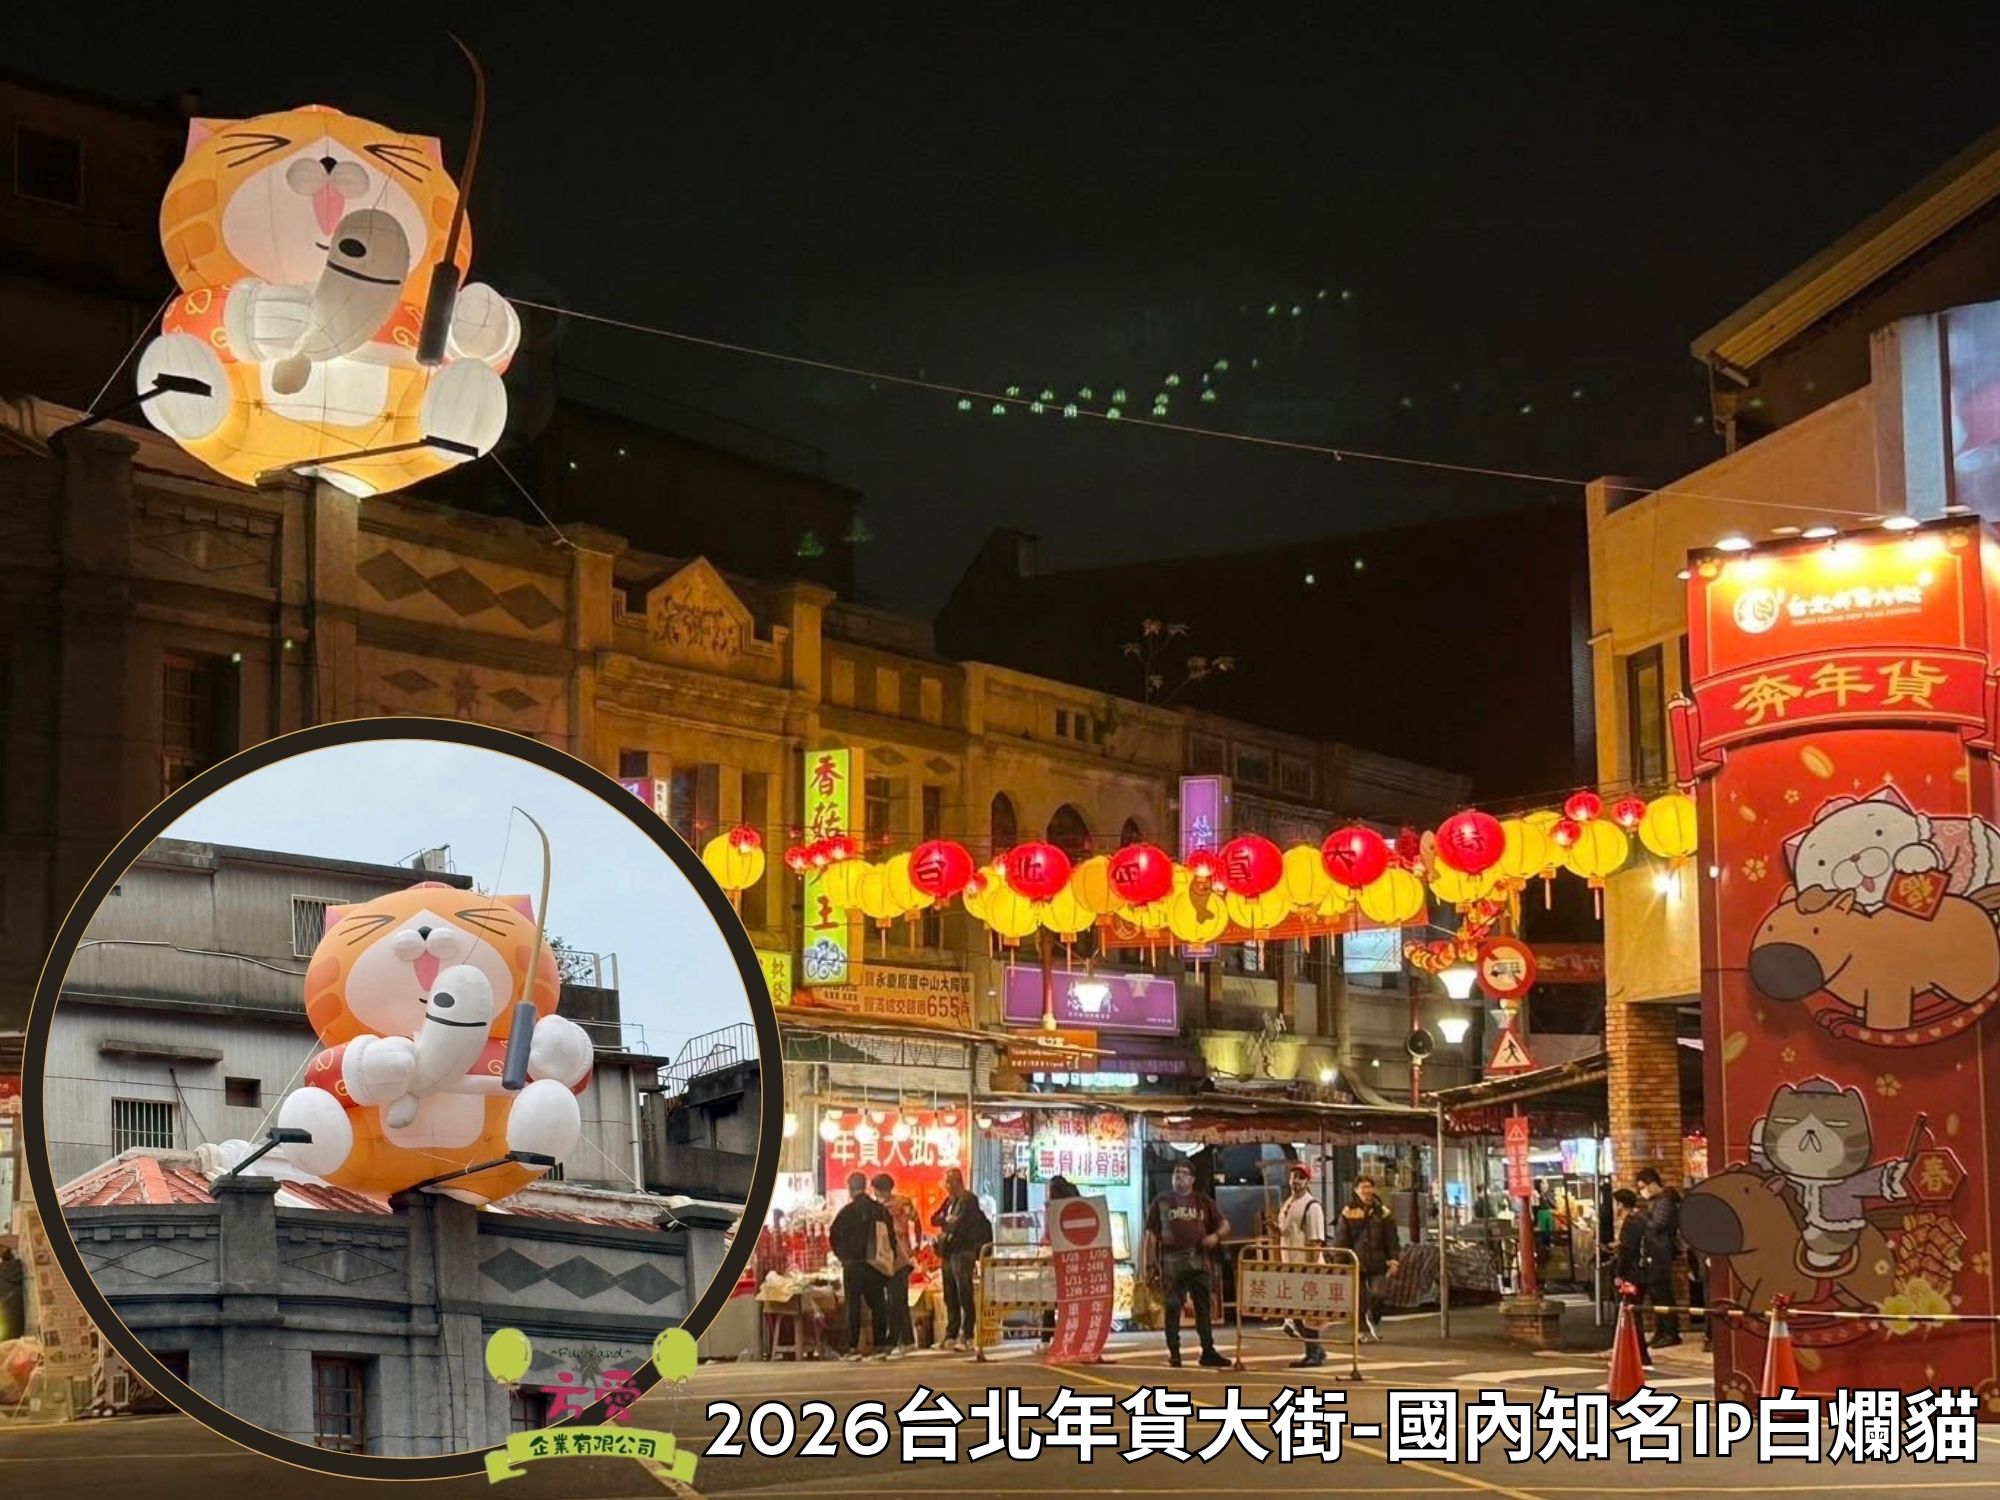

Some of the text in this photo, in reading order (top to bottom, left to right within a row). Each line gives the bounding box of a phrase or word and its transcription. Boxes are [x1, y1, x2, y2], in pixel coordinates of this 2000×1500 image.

[1732, 659, 1948, 725] 奔年貨
[810, 755, 844, 930] 香菇王
[1919, 1159, 1954, 1193] 春
[1249, 1279, 1345, 1302] 禁止停車
